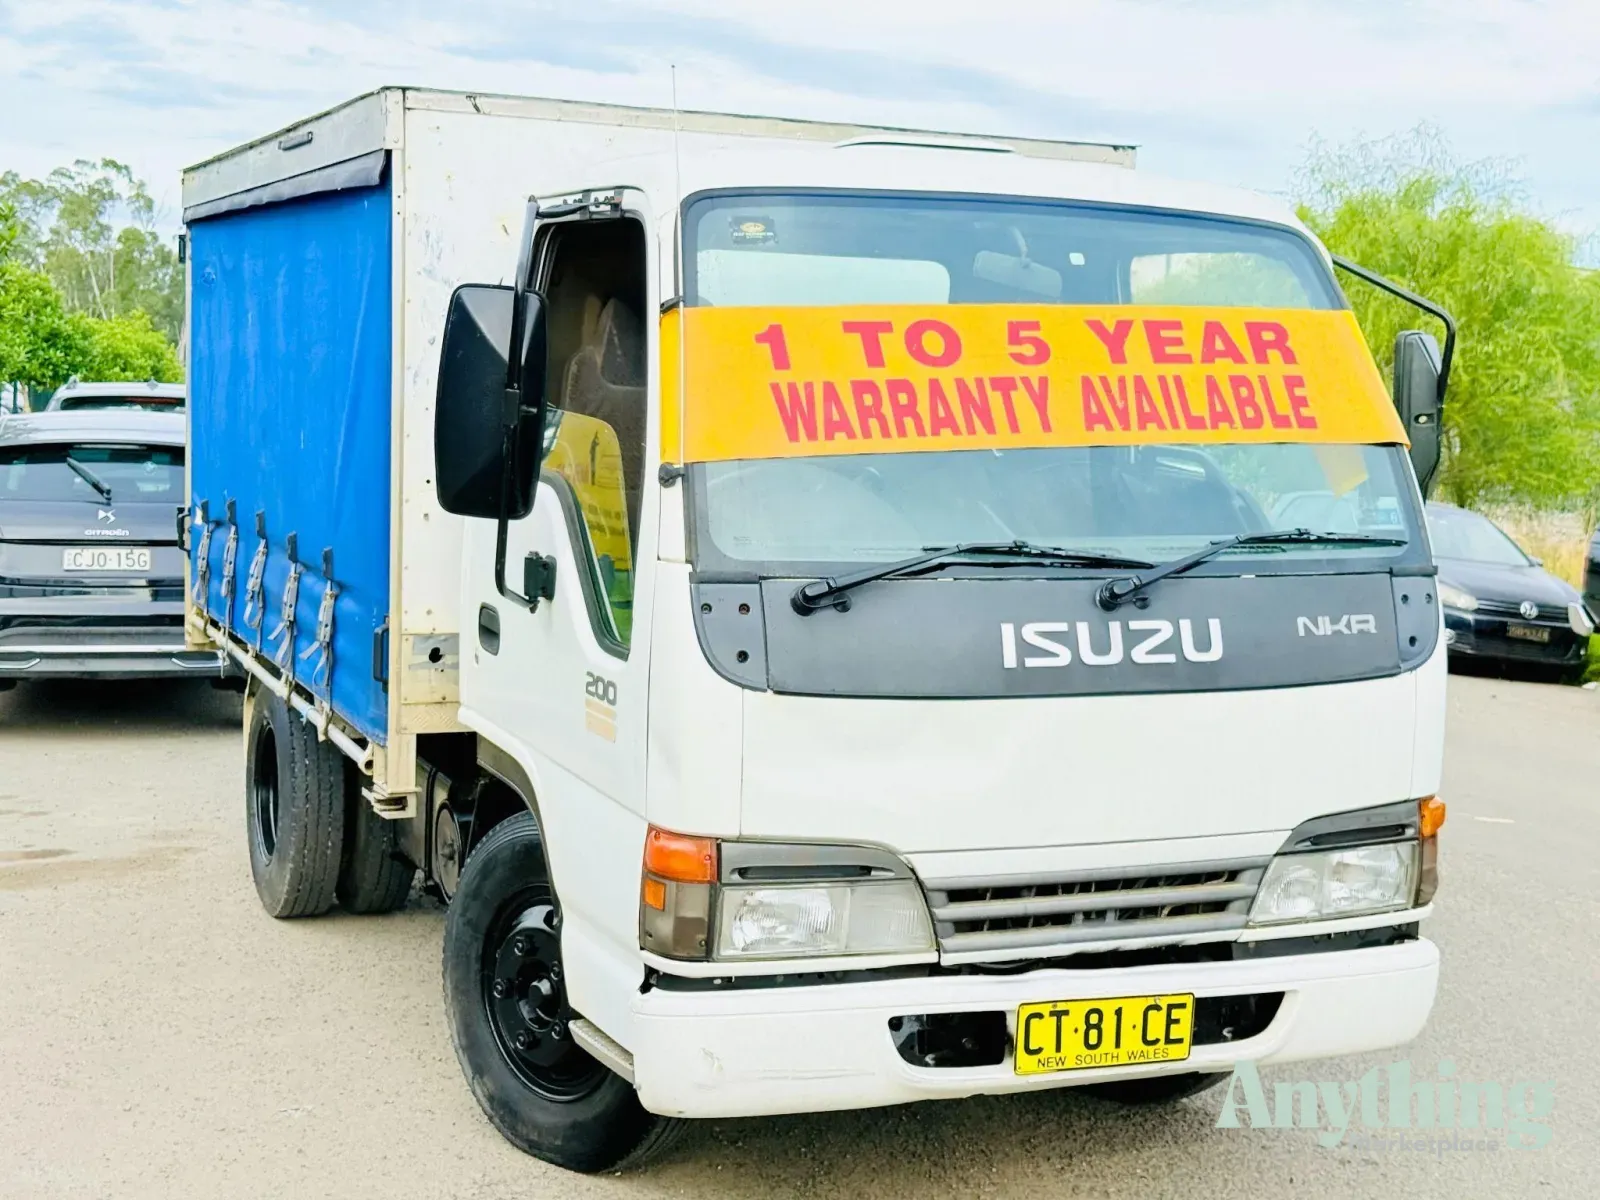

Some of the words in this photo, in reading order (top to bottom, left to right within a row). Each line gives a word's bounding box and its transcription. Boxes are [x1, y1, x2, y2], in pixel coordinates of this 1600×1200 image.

[755, 324, 791, 371] 1
[841, 319, 963, 369] TO
[1006, 320, 1051, 366] 5
[1084, 319, 1299, 365] YEAR
[769, 376, 1053, 443] WARRANTY
[1080, 374, 1318, 432] AVAILABLE
[1001, 618, 1223, 668] ISUZU
[1297, 614, 1377, 636] NKR
[586, 671, 618, 706] 200
[1037, 1056, 1067, 1068] NEW
[1075, 1052, 1119, 1065] SOUTH
[1126, 1048, 1169, 1061] WALES
